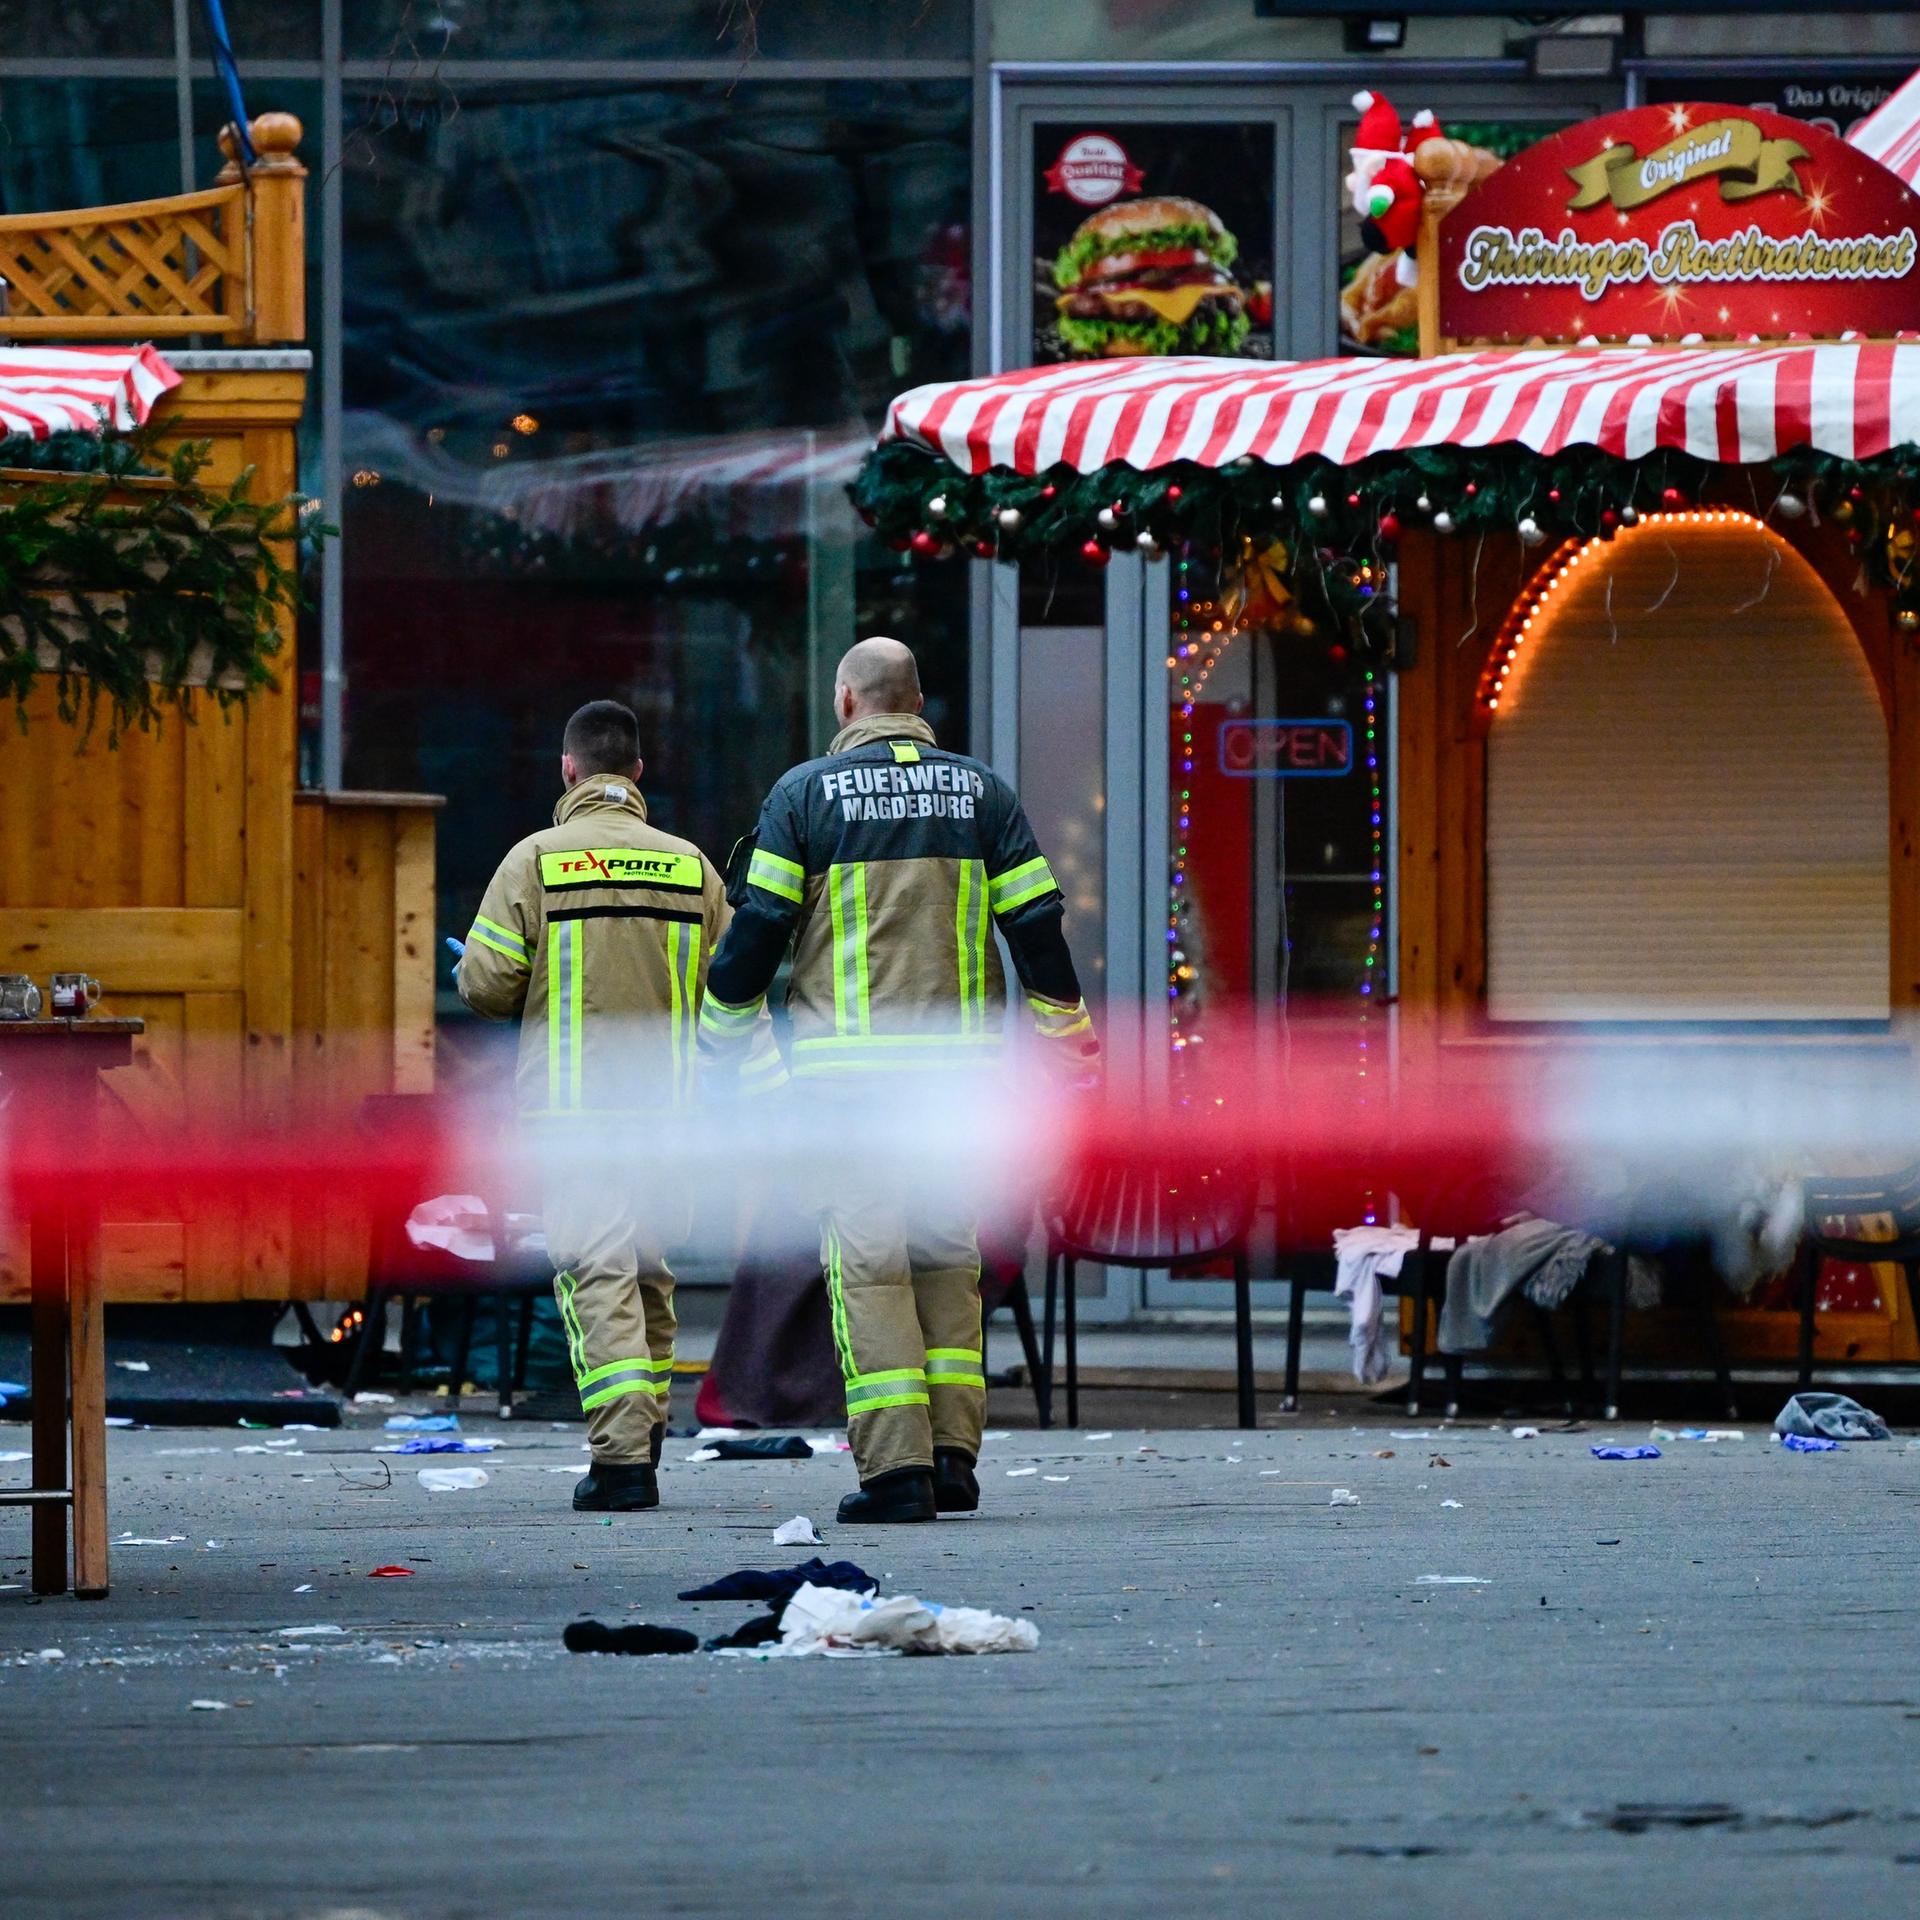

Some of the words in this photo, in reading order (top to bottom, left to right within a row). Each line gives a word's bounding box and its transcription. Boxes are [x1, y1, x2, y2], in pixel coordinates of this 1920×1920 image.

[1784, 84, 1824, 107] Das
[1640, 127, 1732, 188] Original
[1460, 226, 1650, 300] Thüringer
[1650, 219, 1917, 283] Rostbratwurst
[1226, 727, 1348, 766] OPEN
[821, 765, 984, 801] FEUERWEHR
[841, 793, 975, 822] MAGDEBURG
[623, 870, 658, 878] PROTECTING
